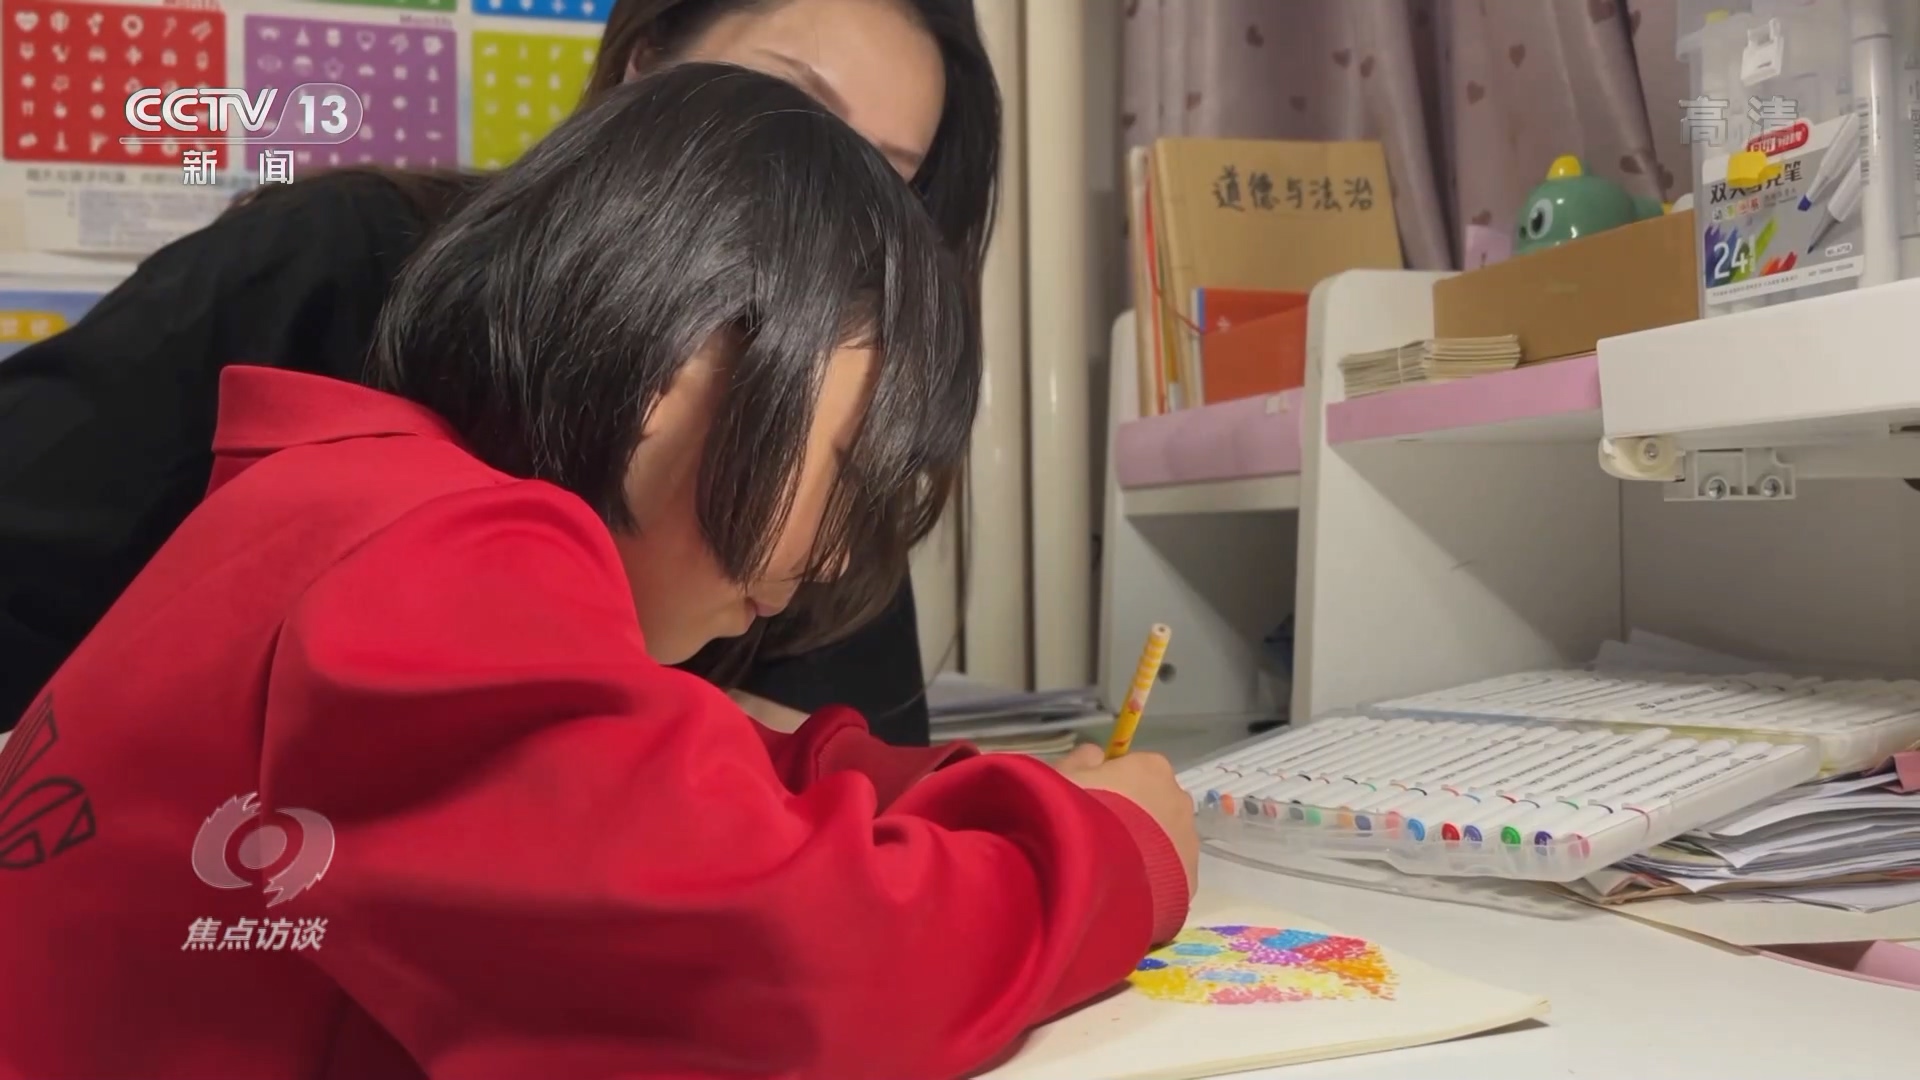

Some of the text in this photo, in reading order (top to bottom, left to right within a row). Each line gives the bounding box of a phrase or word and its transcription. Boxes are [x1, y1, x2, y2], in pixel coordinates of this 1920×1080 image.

[1212, 164, 1375, 212] 道德与法治
